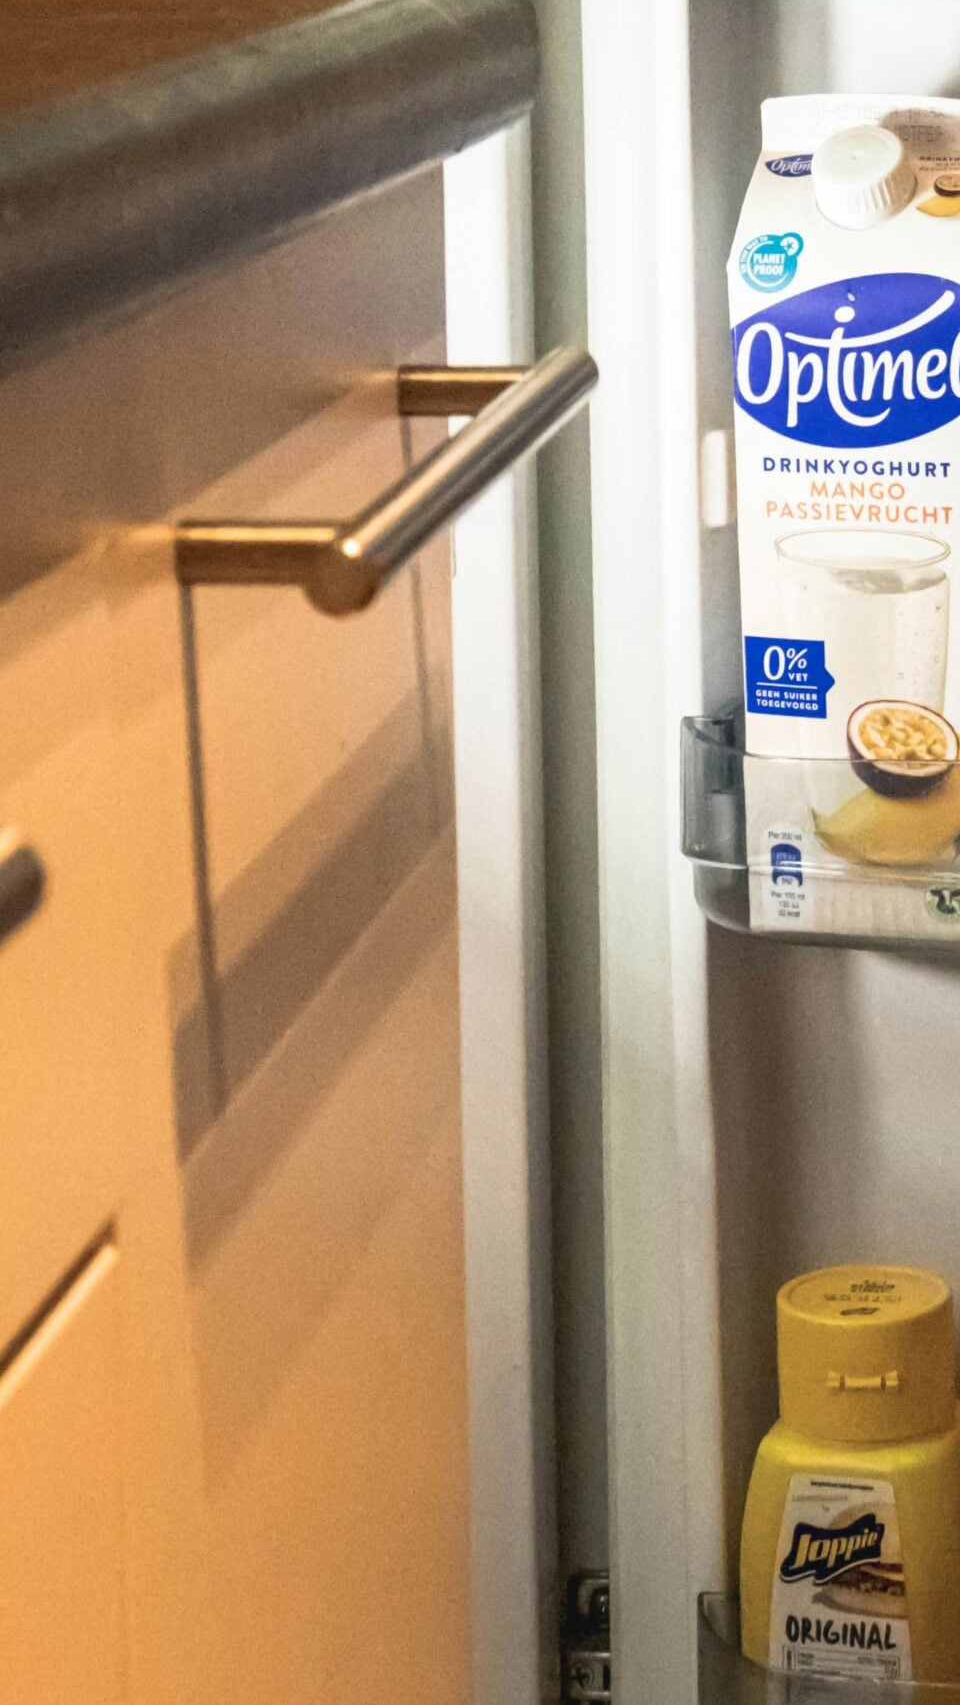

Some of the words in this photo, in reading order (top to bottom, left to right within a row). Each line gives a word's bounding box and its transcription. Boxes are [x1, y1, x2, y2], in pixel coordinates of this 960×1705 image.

[753, 253, 785, 265] PLANET
[753, 264, 785, 276] PROOF
[763, 457, 951, 478] DRINKYOGHURT
[810, 481, 906, 500] MANGO
[766, 501, 953, 524] PASSIEVRUCHT
[763, 646, 808, 681] 0%
[788, 673, 808, 682] VET
[755, 689, 780, 698] GEEN
[783, 692, 818, 701] SUIKER
[756, 699, 819, 710] TOEGEVOEGD
[789, 1526, 880, 1569] Joppie
[786, 1614, 898, 1651] ORIGINAL
